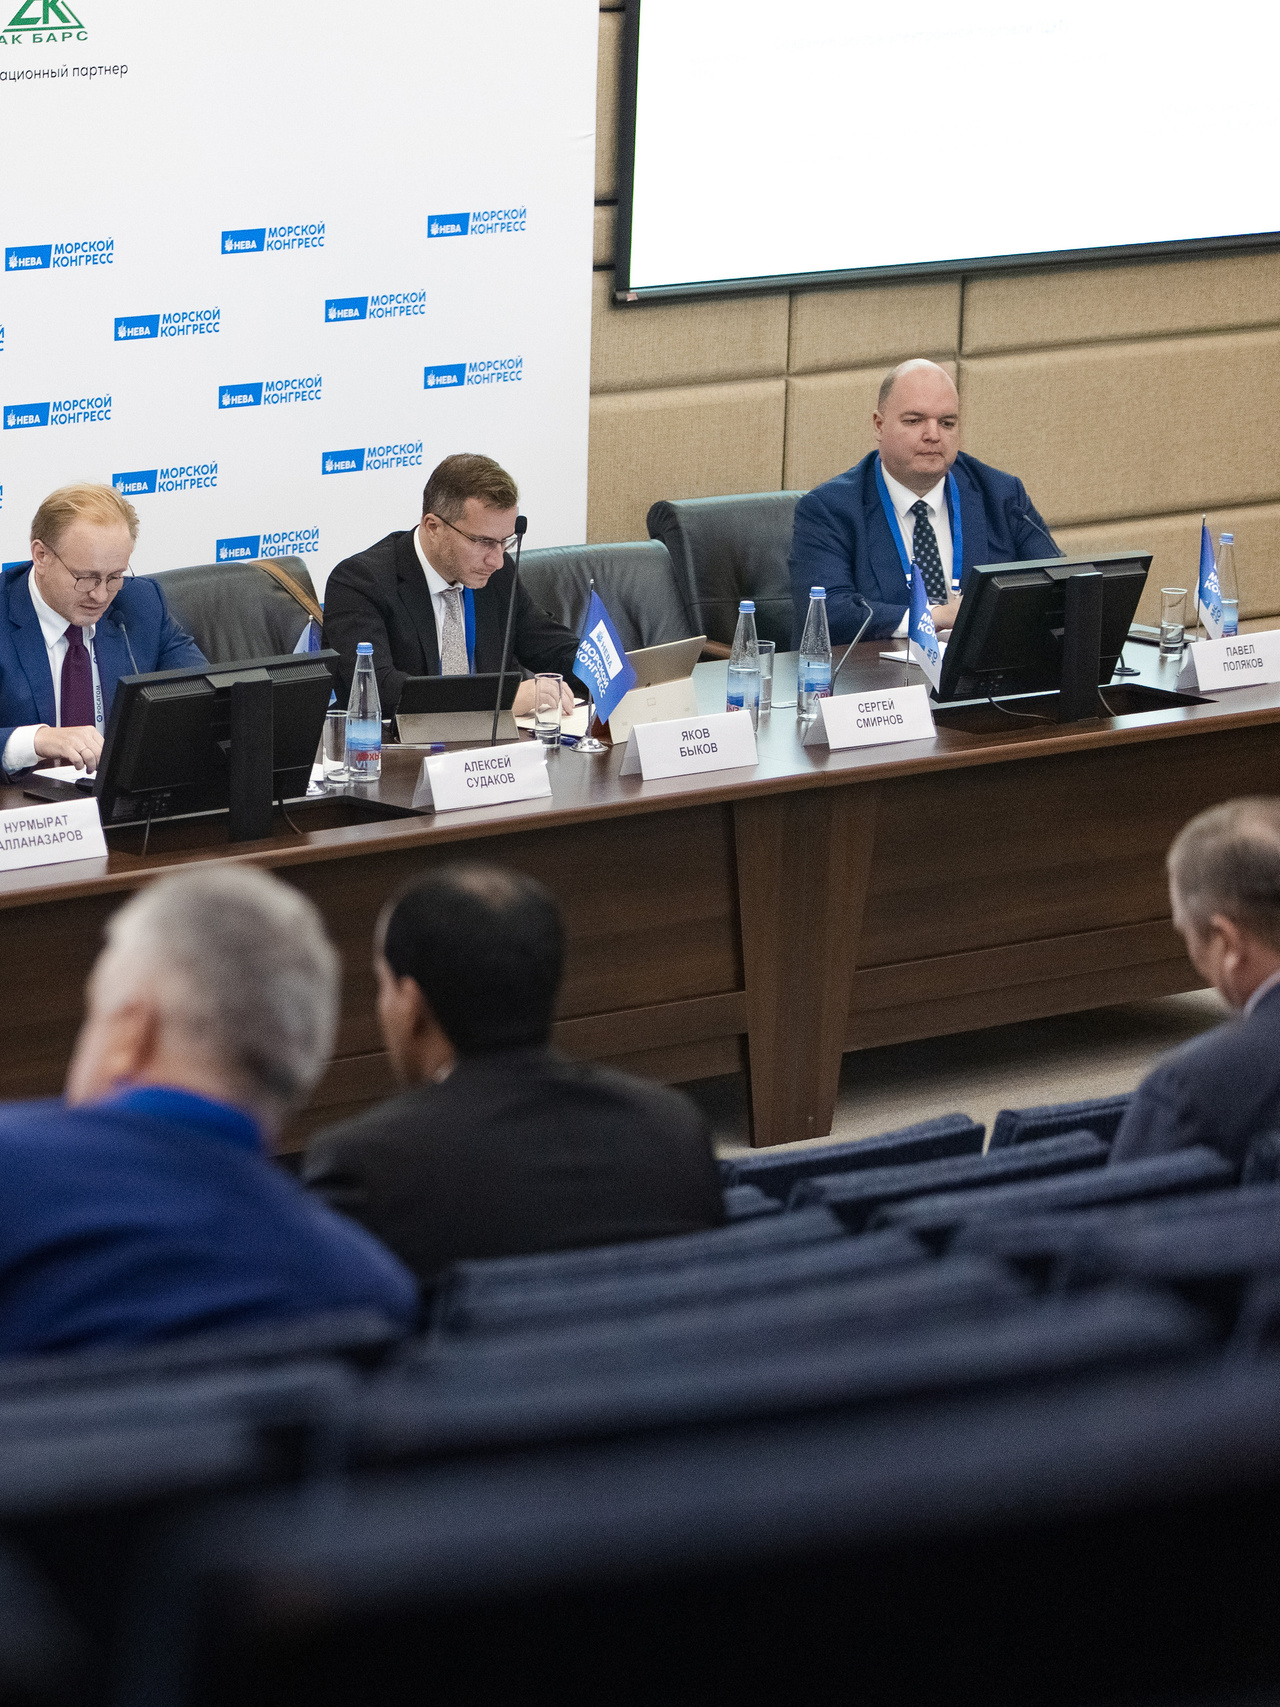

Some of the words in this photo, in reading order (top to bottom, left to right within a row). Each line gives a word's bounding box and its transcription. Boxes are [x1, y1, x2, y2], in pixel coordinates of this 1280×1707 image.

[32, 31, 89, 44] БАРС
[72, 63, 129, 80] партнер
[472, 206, 526, 222] МОРСКОЙ
[268, 221, 325, 238] МОРСКОЙ
[440, 223, 461, 234] НЕВА
[471, 221, 525, 234] КОНГРЕСС
[54, 237, 114, 255] МОРСКОЙ
[234, 239, 256, 250] НЕВА
[267, 236, 324, 251] КОНГРЕСС
[19, 256, 42, 268] НЕВА
[53, 253, 113, 268] КОНГРЕСС
[371, 289, 426, 306] МОРСКОЙ
[162, 306, 220, 324] МОРСКОЙ
[338, 308, 359, 319] НЕВА
[369, 304, 425, 319] КОНГРЕСС
[128, 326, 150, 337] НЕВА
[161, 322, 220, 337] КОНГРЕСС
[469, 358, 522, 372] МОРСКОЙ
[265, 374, 322, 392] МОРСКОЙ
[437, 374, 457, 385] НЕВА
[467, 370, 522, 385] КОНГРЕСС
[52, 394, 112, 412] МОРСКОЙ
[231, 394, 253, 405] НЕВА
[264, 389, 321, 405] КОНГРЕСС
[17, 414, 40, 425] НЕВА
[51, 409, 111, 425] КОНГРЕСС
[367, 440, 423, 458] МОРСКОЙ
[160, 460, 218, 479] МОРСКОЙ
[335, 460, 356, 471] НЕВА
[366, 455, 422, 470] КОНГРЕСС
[126, 481, 148, 493] НЕВА
[158, 476, 217, 492] КОНГРЕСС
[262, 527, 319, 545] МОРСКОЙ
[228, 547, 252, 558] НЕВА
[261, 541, 318, 558] КОНГРЕСС
[1225, 644, 1255, 657] ПАВЕЛ
[580, 640, 610, 689] МОРСКОЙ
[1222, 657, 1264, 672] ПОЛЯКОВ
[857, 698, 895, 713] СЕРГЕЙ
[856, 714, 904, 728] СМИРНОВ
[681, 728, 711, 741] ЯКОВ
[679, 742, 718, 757] БЫКОВ
[464, 755, 512, 773] АЛЕКСЕЙ
[466, 772, 516, 788] СУДАКОВ
[3, 815, 69, 834] НУРМЫРАТ
